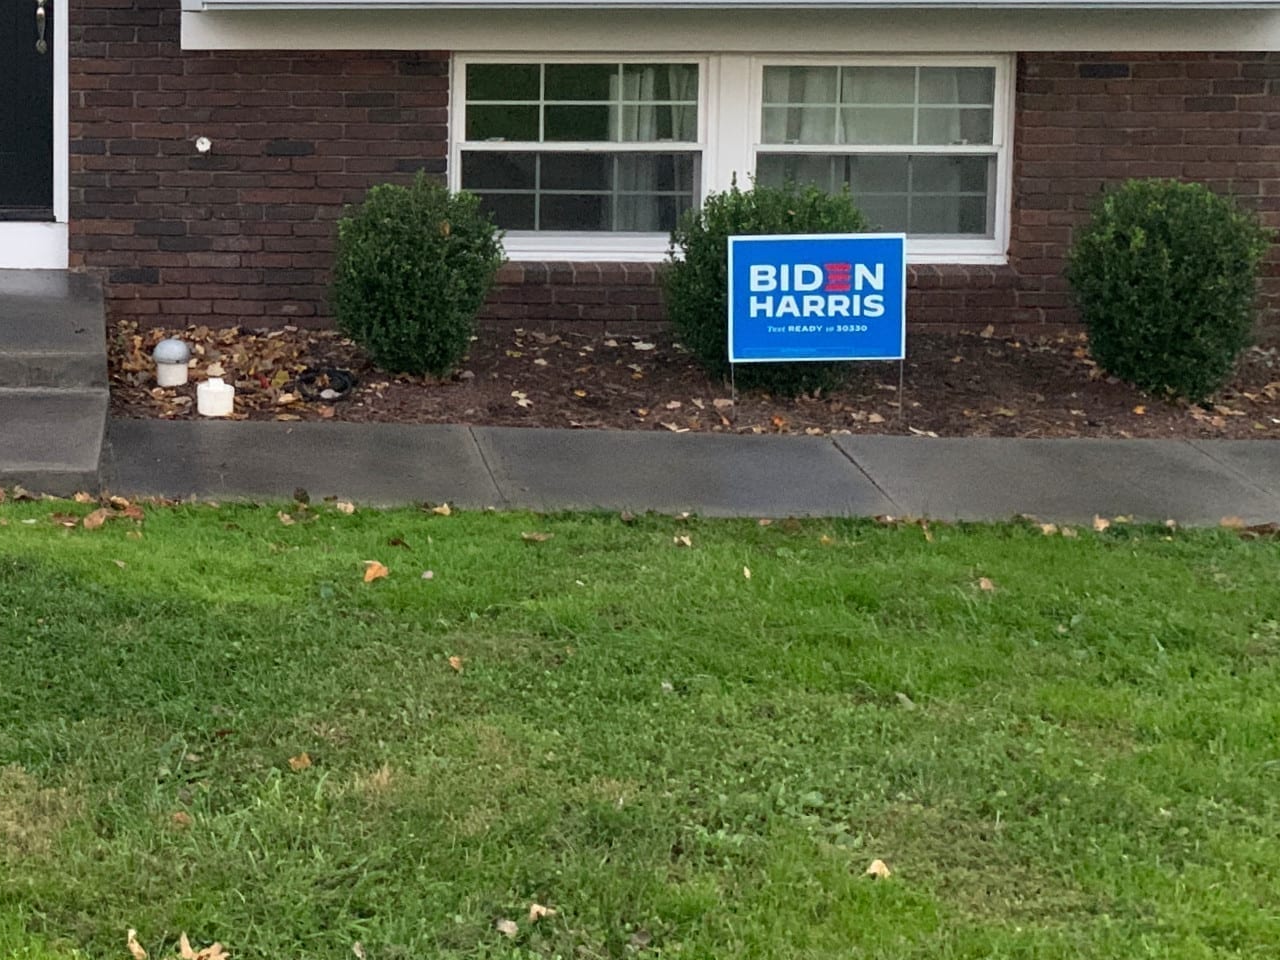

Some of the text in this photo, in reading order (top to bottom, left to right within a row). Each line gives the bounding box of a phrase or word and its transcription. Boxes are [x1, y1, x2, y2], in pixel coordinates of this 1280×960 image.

[750, 262, 884, 292] BIDEN
[750, 294, 885, 317] HARRIS
[787, 325, 823, 333] READY
[836, 324, 868, 333] 30330
